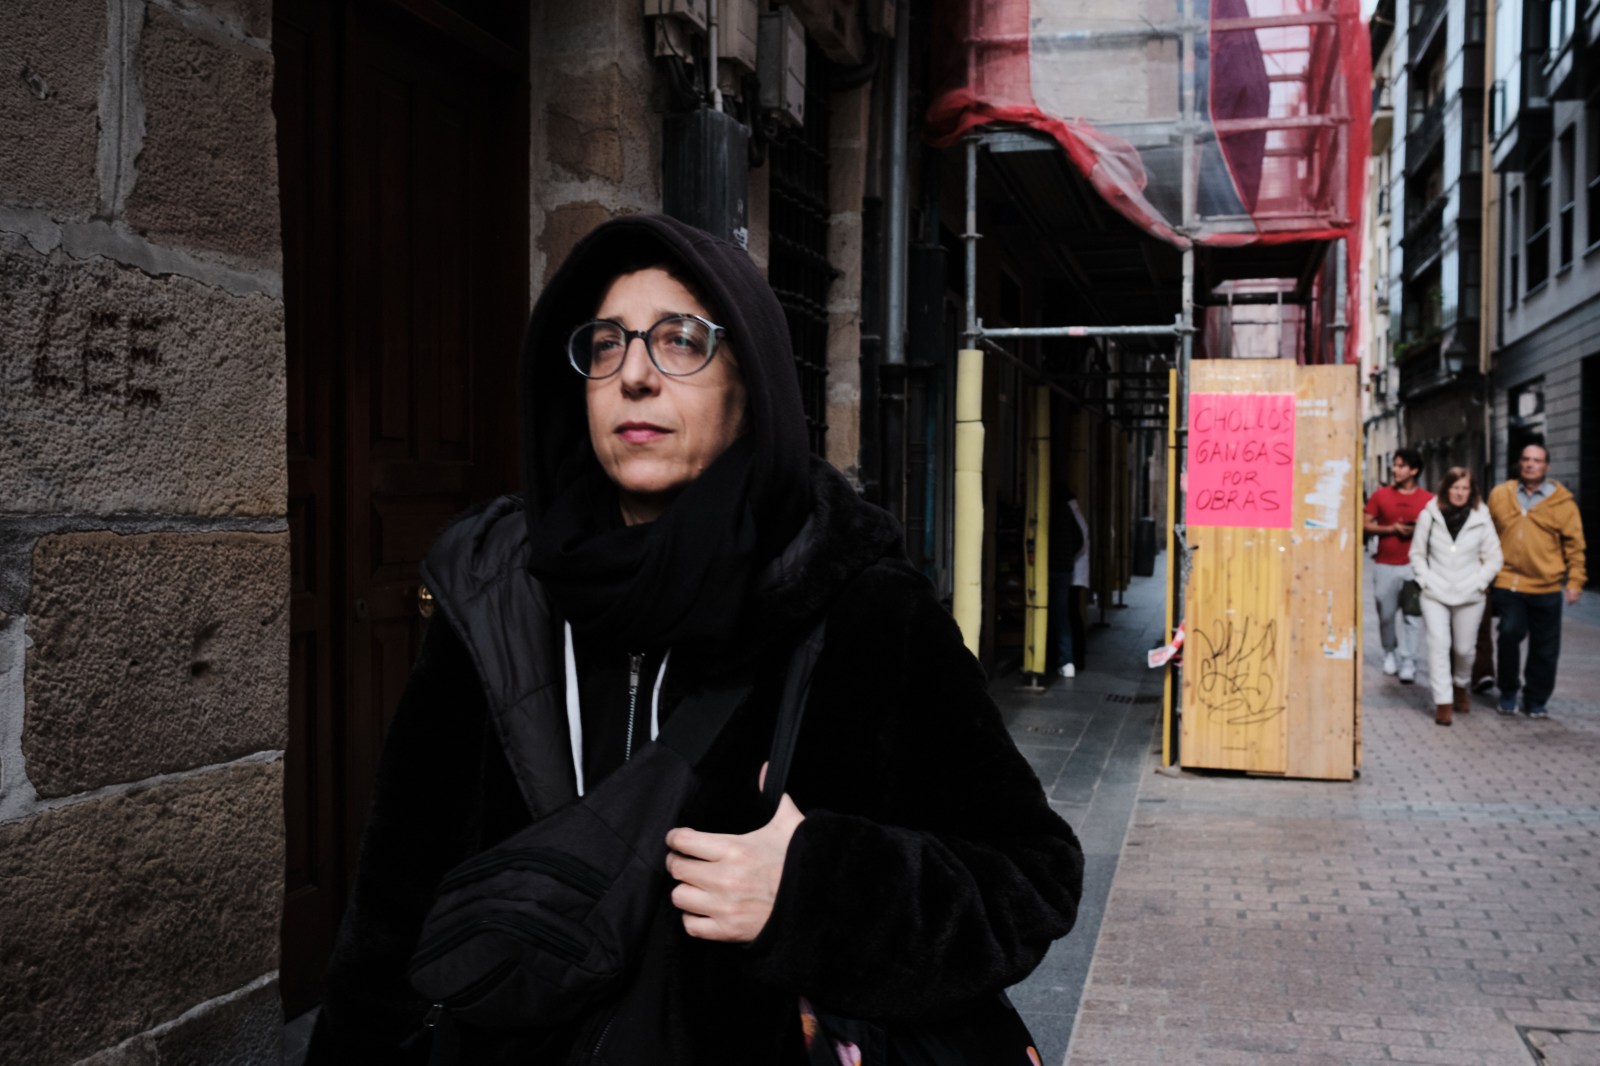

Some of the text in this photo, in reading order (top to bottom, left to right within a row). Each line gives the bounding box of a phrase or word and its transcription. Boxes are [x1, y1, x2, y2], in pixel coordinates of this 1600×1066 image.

[1194, 408, 1291, 433] CHOLLOS
[1195, 440, 1292, 466] GANGAS
[1222, 471, 1260, 487] POR
[1195, 489, 1280, 512] OBRAS
